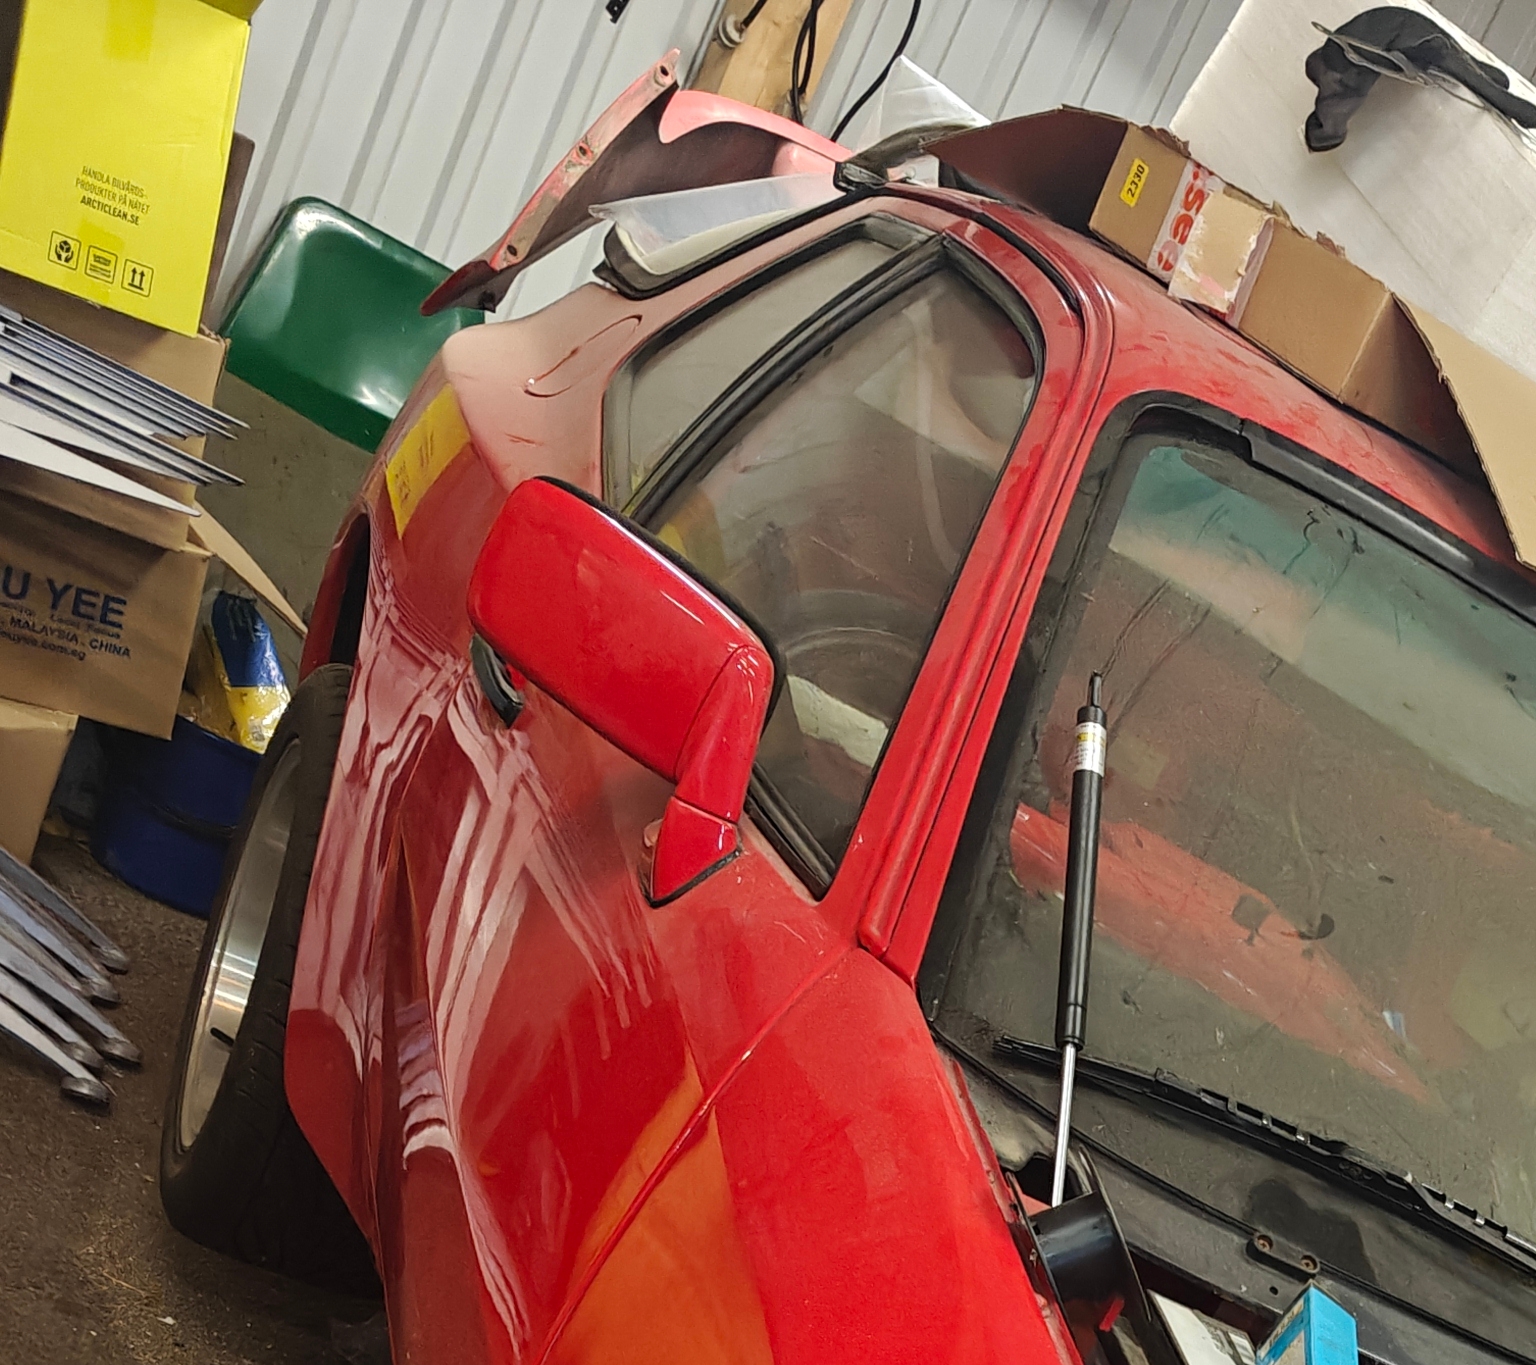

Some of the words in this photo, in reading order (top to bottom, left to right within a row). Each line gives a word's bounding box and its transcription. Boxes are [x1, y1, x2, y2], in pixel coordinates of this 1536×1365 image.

[75, 177, 118, 201] PRODUKTER
[81, 165, 110, 186] HANDLA
[1126, 164, 1145, 198] 2330
[80, 195, 140, 226] ARCTICLEAN.SE
[46, 577, 127, 630] YEE
[9, 615, 79, 647] MALAYSIA
[88, 637, 131, 660] CHINA
